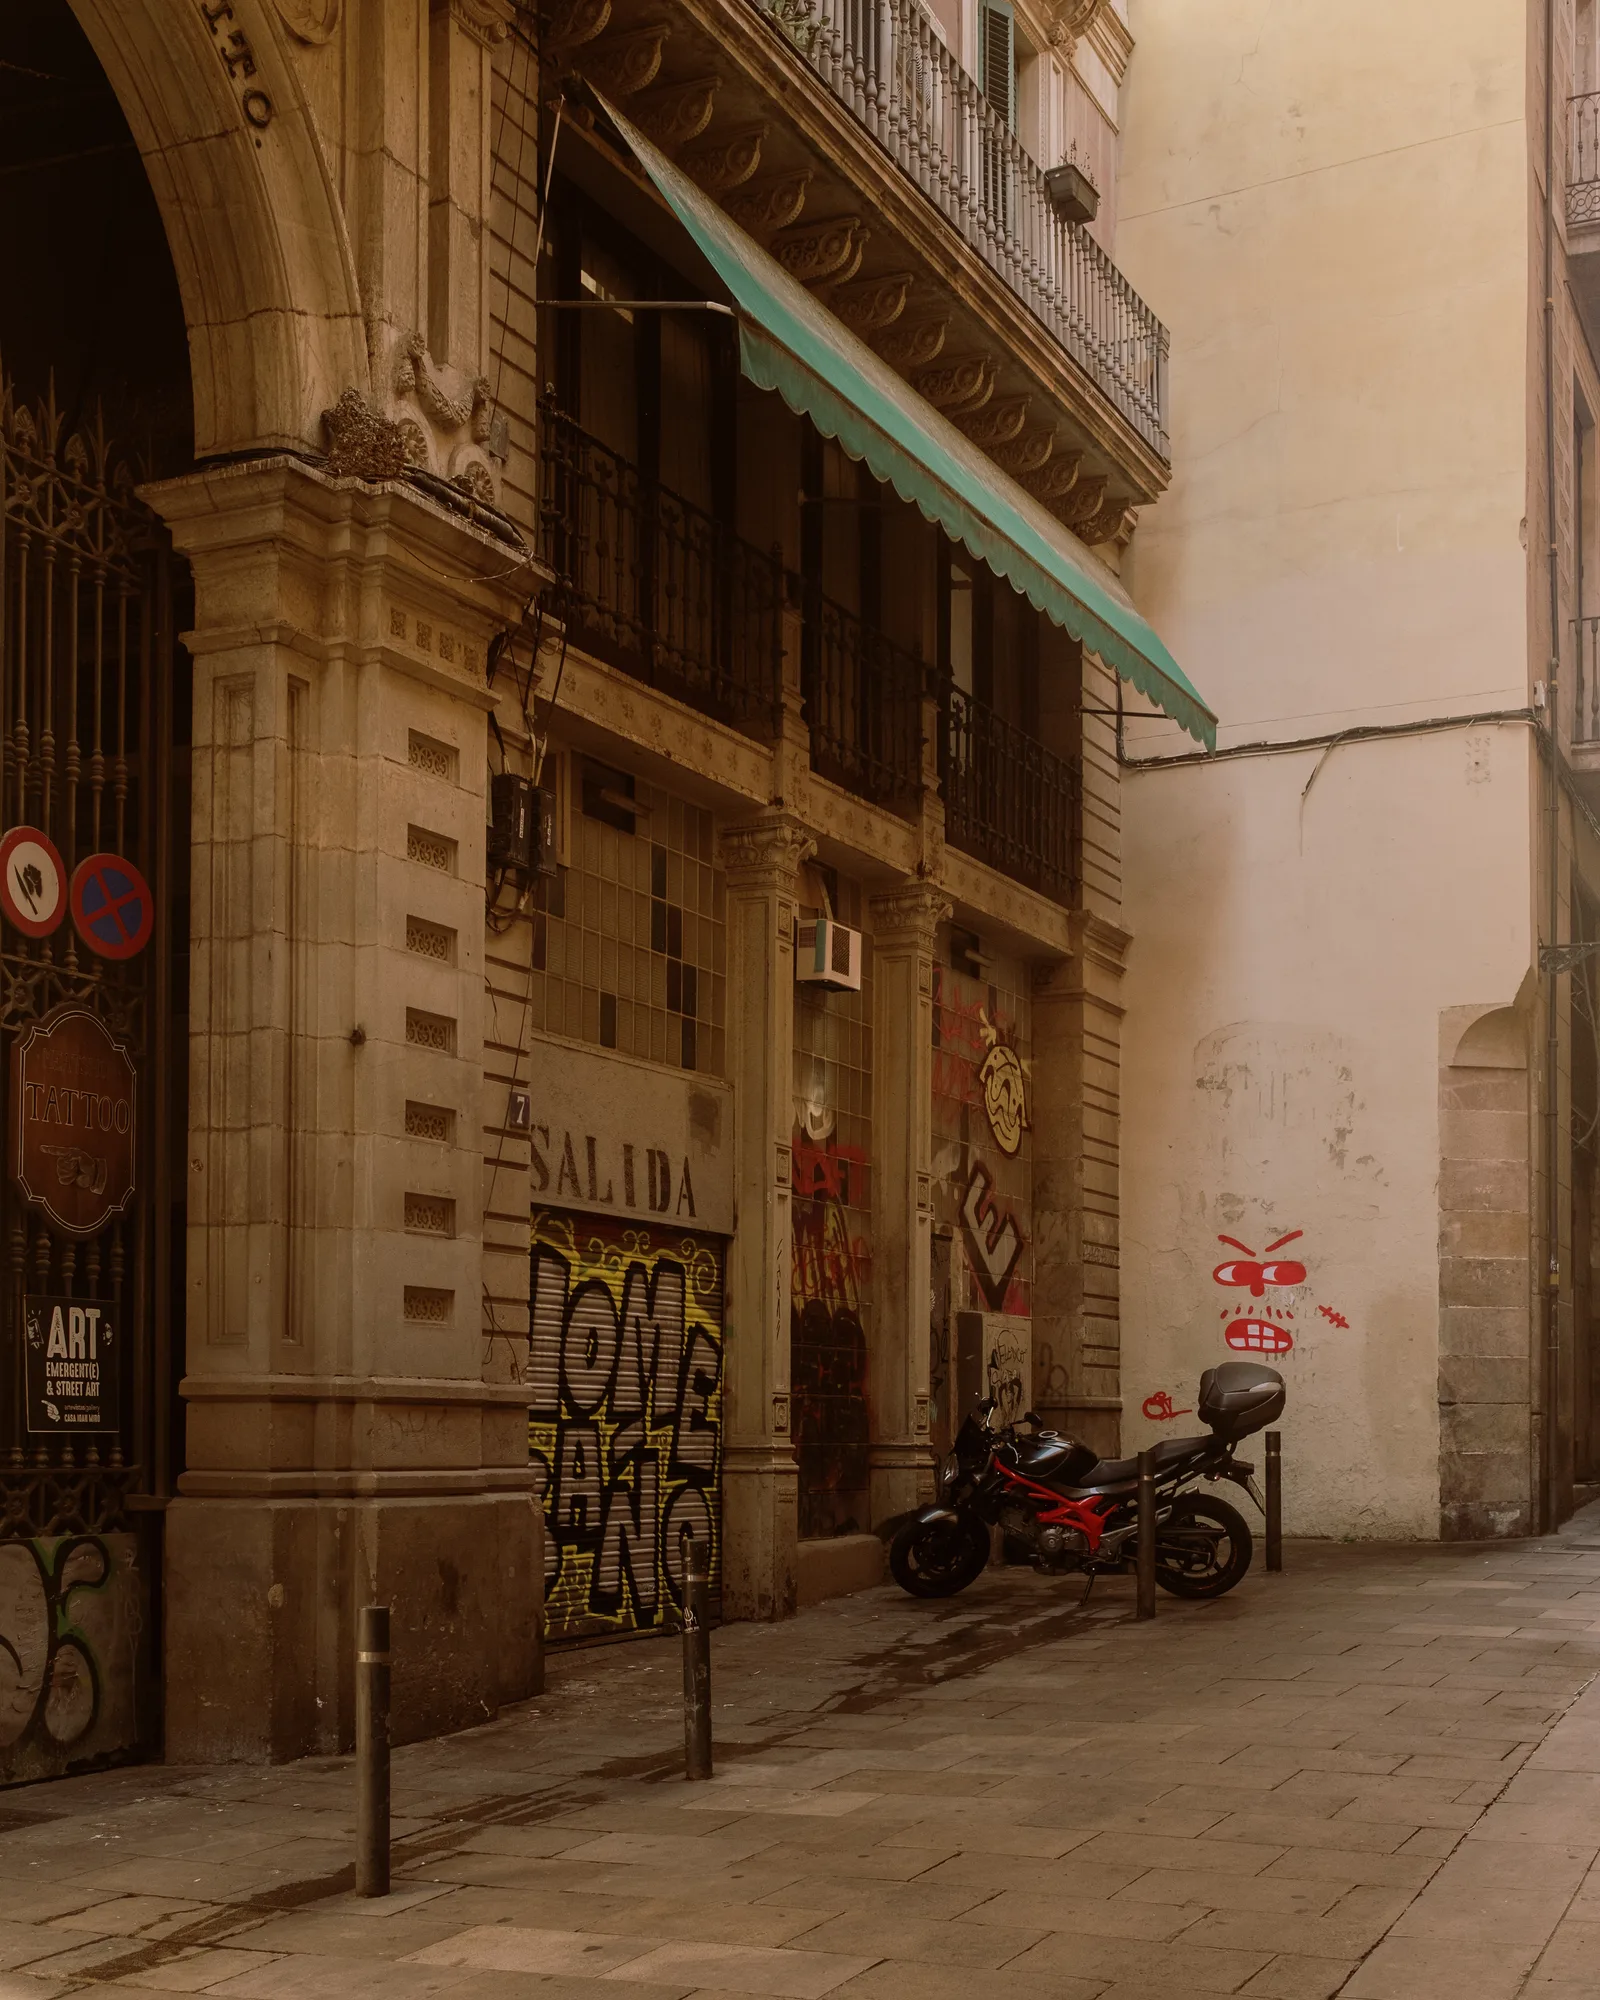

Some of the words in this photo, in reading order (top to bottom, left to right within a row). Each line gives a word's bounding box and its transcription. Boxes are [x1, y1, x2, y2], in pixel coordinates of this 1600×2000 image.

[25, 1081, 131, 1135] TATTOO
[516, 1095, 526, 1125] 7
[531, 1124, 697, 1218] SALIDA
[46, 1305, 101, 1360] ART
[46, 1361, 100, 1380] EMERGENT(E)
[46, 1380, 55, 1396] &
[56, 1380, 84, 1397] STREET
[85, 1381, 100, 1397] ART
